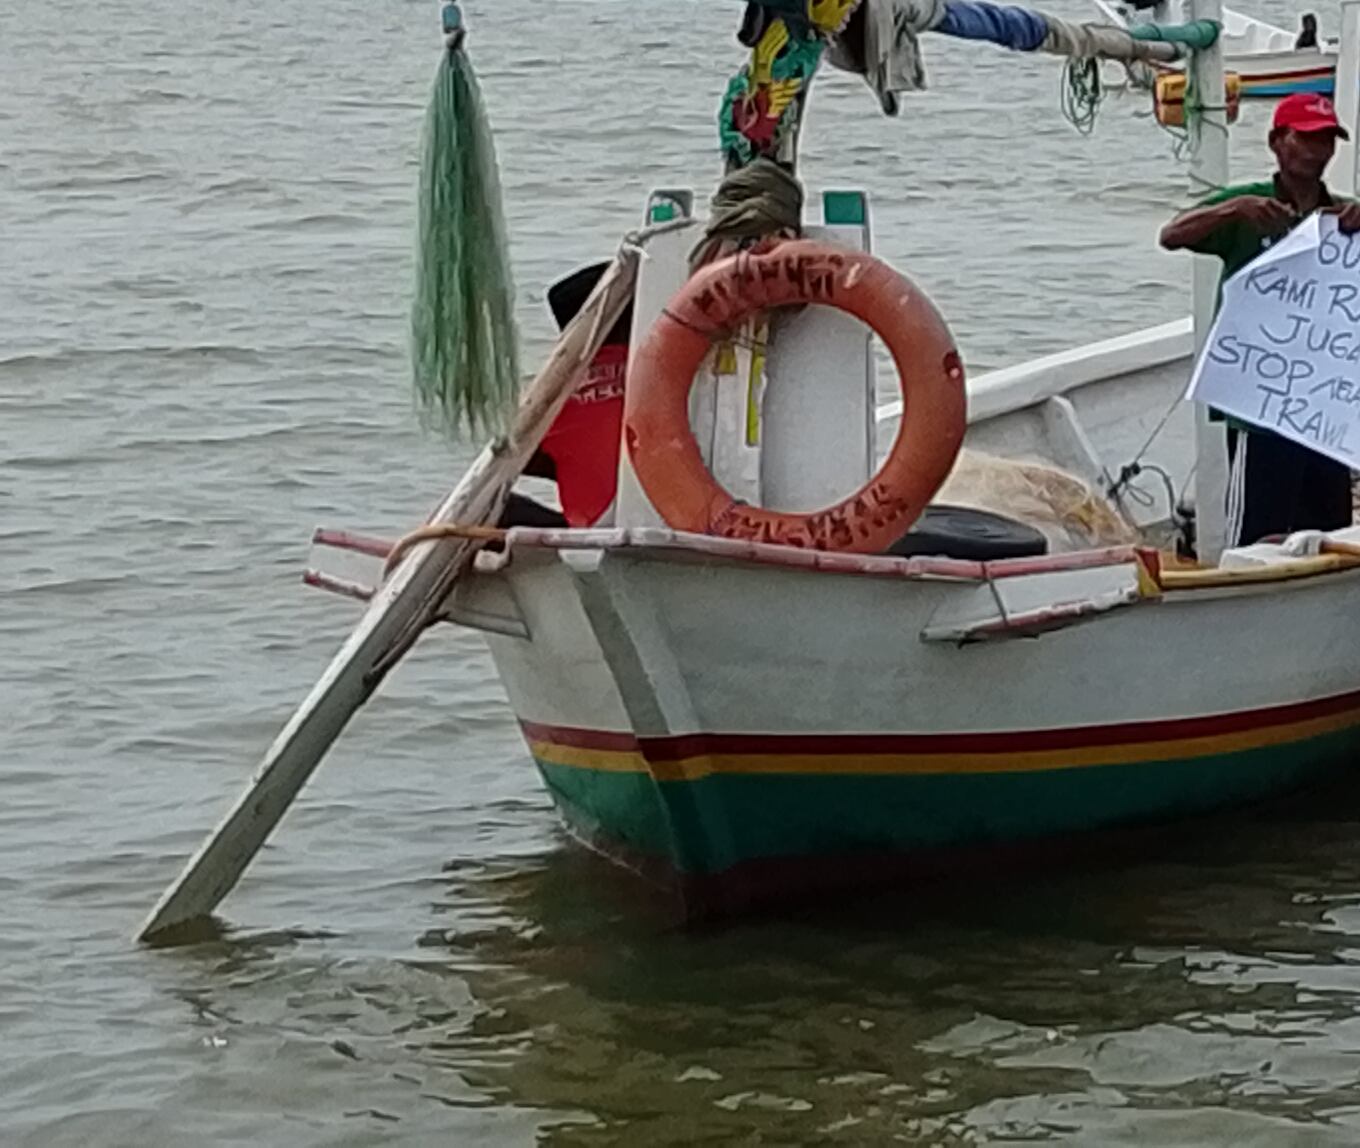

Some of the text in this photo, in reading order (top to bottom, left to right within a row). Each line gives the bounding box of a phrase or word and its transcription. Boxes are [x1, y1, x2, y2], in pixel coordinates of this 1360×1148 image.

[1244, 267, 1319, 310] KAMI
[1208, 335, 1315, 397] STOP
[1256, 383, 1355, 456] TRAWL
